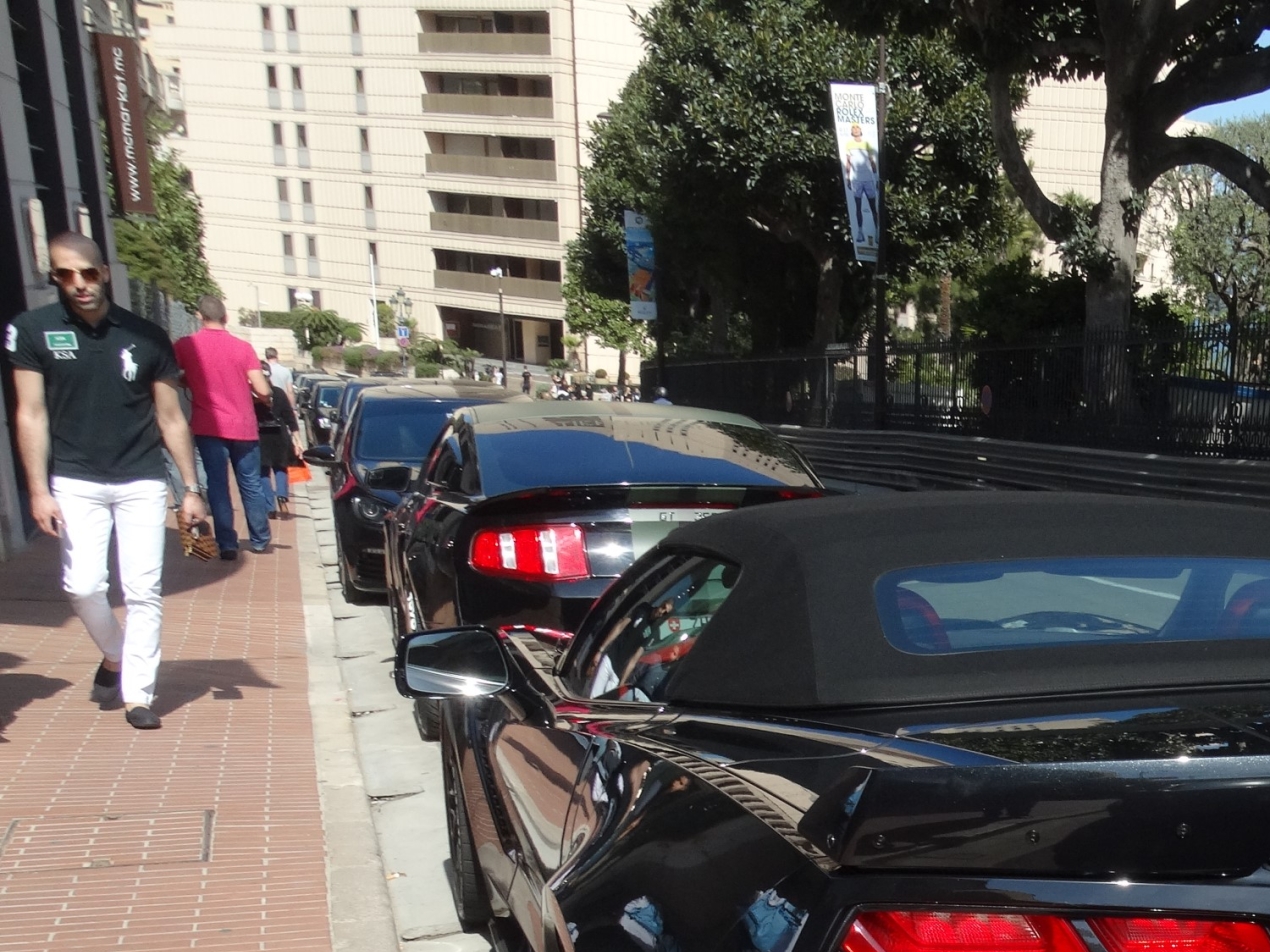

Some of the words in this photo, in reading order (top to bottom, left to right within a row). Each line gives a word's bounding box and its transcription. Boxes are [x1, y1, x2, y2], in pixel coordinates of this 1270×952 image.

[835, 93, 863, 101] MONTE
[836, 107, 864, 116] ROLEX
[112, 46, 142, 202] www.mcmarket.mc
[837, 115, 875, 124] MASTERS
[53, 350, 77, 360] KSA
